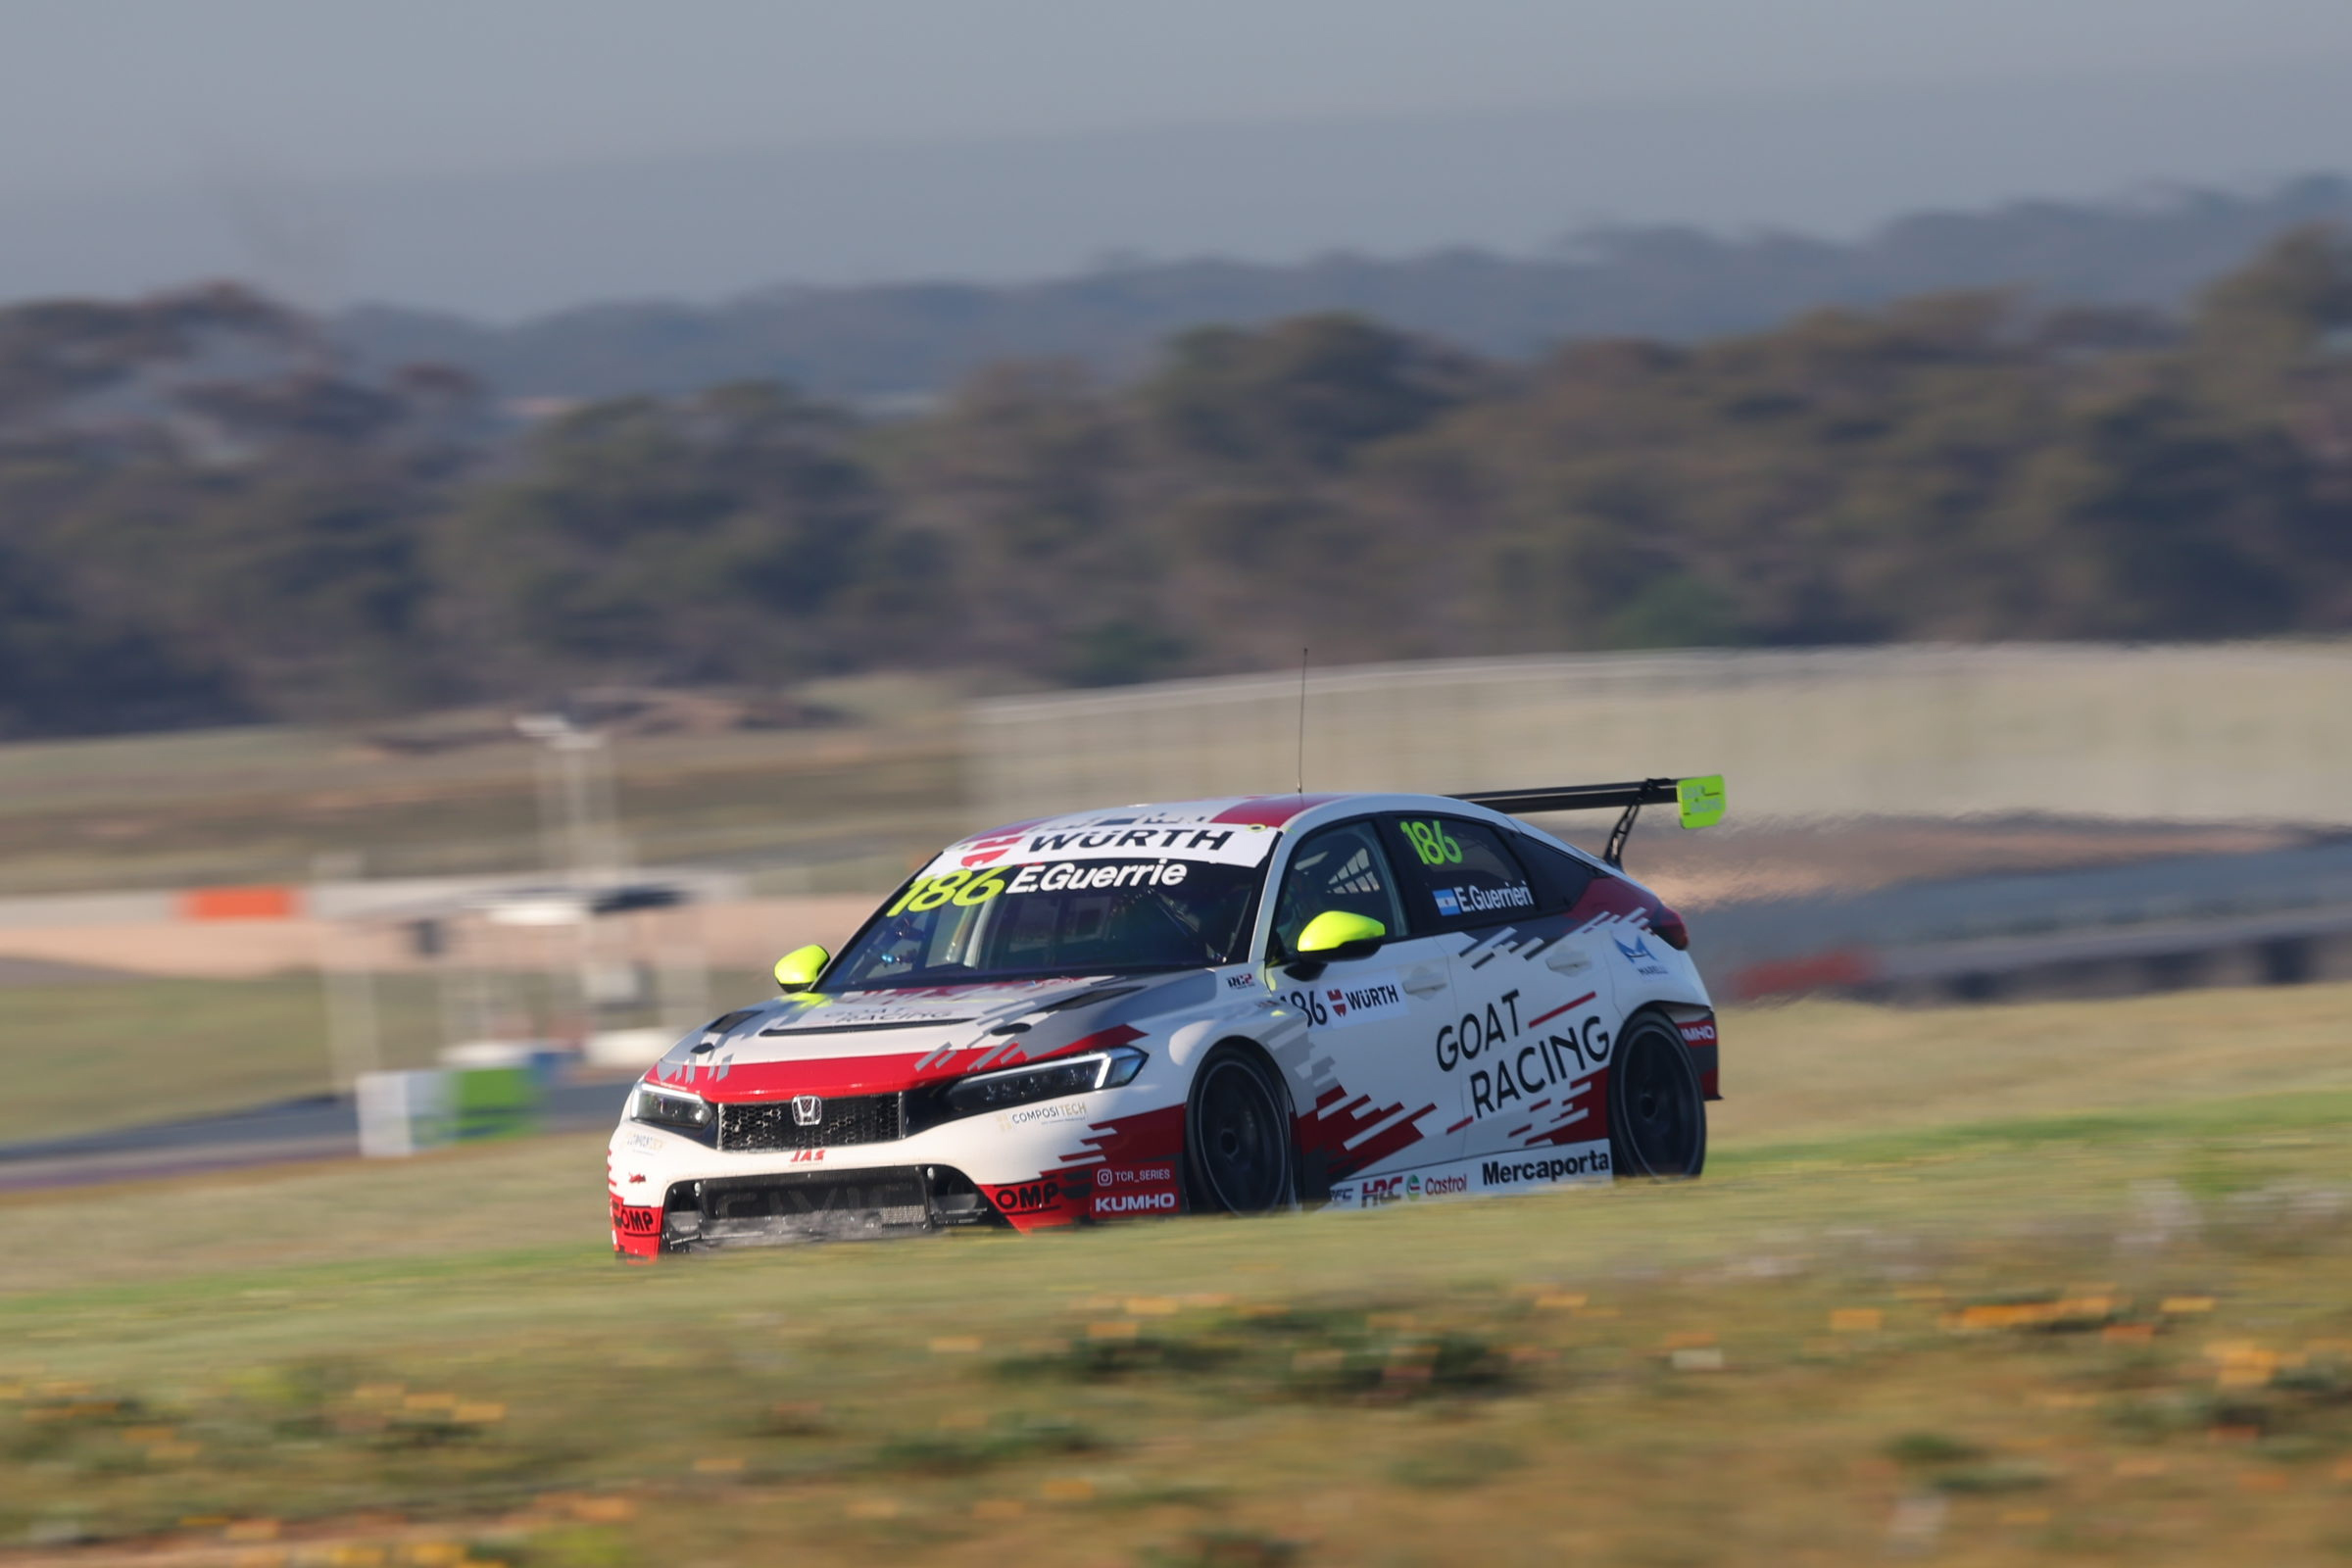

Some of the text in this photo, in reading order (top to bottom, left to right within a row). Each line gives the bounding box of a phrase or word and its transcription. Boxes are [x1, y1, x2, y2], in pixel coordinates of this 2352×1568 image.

[1028, 828, 1235, 854] WÜRTH
[1399, 819, 1463, 865] 186
[887, 865, 1012, 917] 186
[1006, 858, 1188, 895] E.Guerrie
[1453, 880, 1535, 912] E.Guerrieri
[1280, 990, 1328, 1028] 86
[1345, 984, 1399, 1010] WÜRTH
[1436, 989, 1520, 1072] GOAT
[1469, 1015, 1610, 1119] RACING
[790, 1150, 826, 1163] JAS
[1482, 1149, 1610, 1186] Mercaporta
[1114, 1168, 1171, 1183] TCR_SERIES
[1425, 1173, 1468, 1196] Castrol
[996, 1182, 1059, 1210] OMP
[1095, 1193, 1176, 1212] KUMHO
[620, 1209, 655, 1232] OMP
